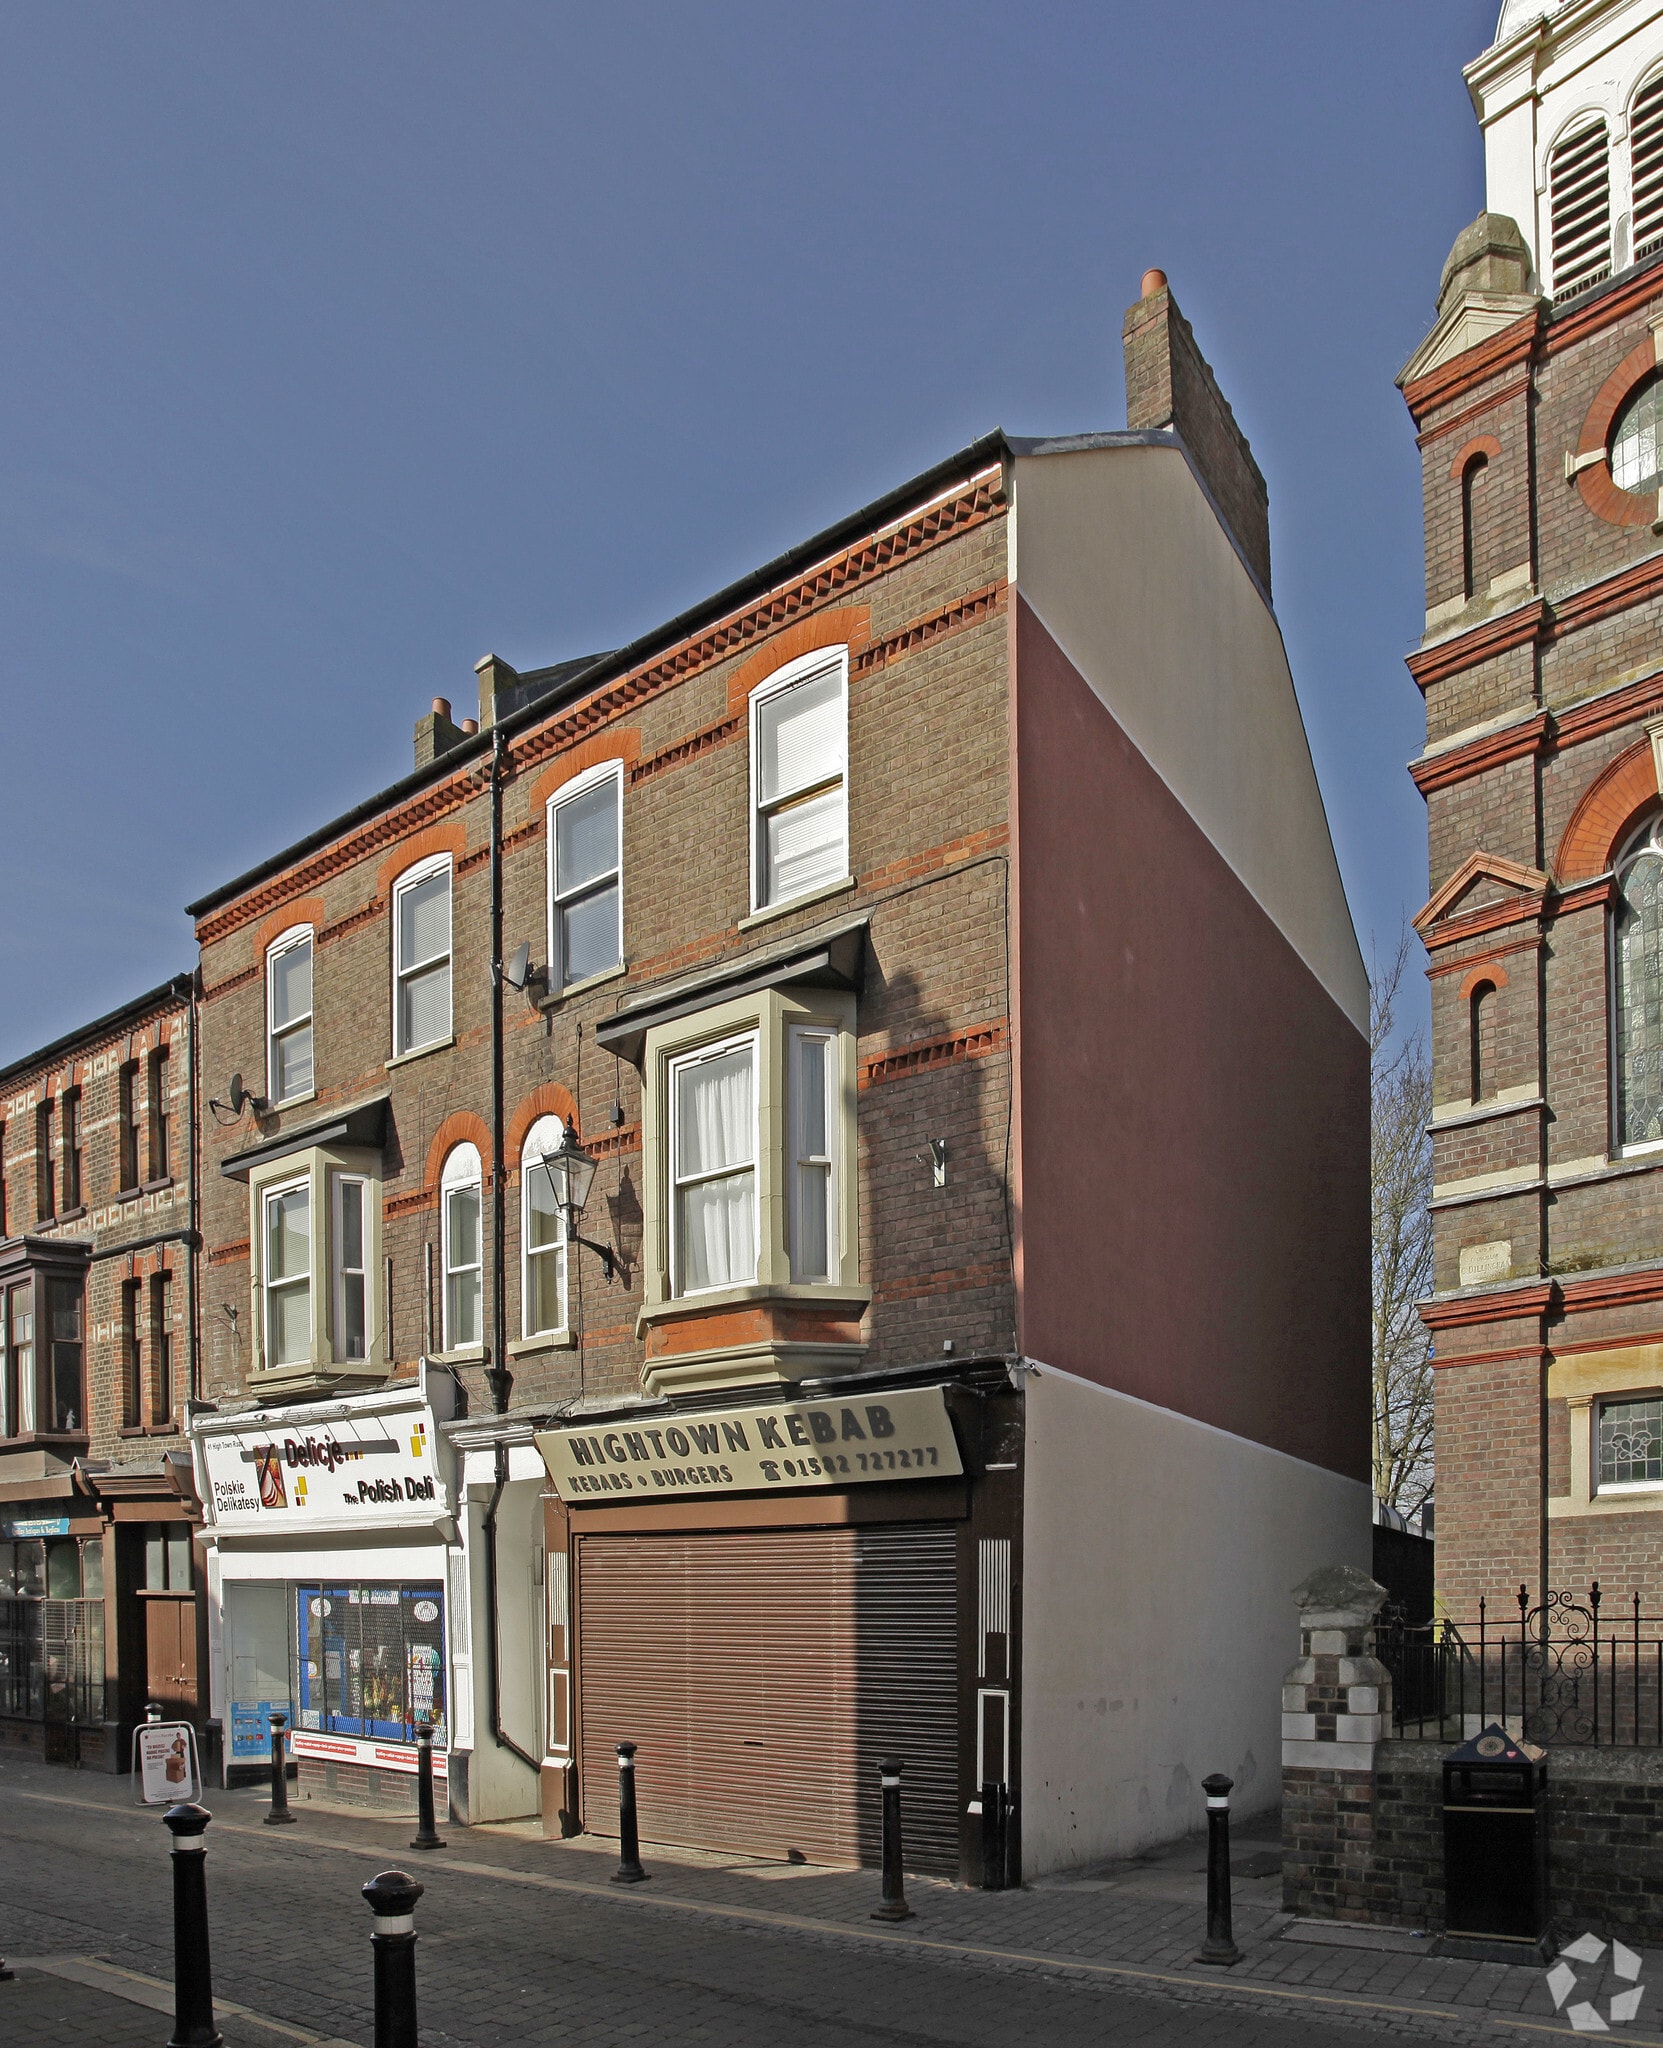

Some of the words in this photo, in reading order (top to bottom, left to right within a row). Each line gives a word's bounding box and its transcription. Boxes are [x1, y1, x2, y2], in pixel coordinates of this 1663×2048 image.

[213, 1442, 221, 1451] High
[221, 1441, 232, 1449] Town
[568, 1421, 751, 1466] HIGHTOWN
[755, 1405, 896, 1449] KEBAB
[567, 1472, 633, 1493] KEBABS
[650, 1464, 733, 1487] BURGERS
[783, 1453, 851, 1478] 01582
[856, 1446, 938, 1472] 727277
[214, 1480, 245, 1496] Polskie
[343, 1493, 359, 1505] The
[357, 1478, 404, 1504] Polish
[404, 1475, 436, 1501] Deli
[216, 1497, 260, 1513] Delikatesy
